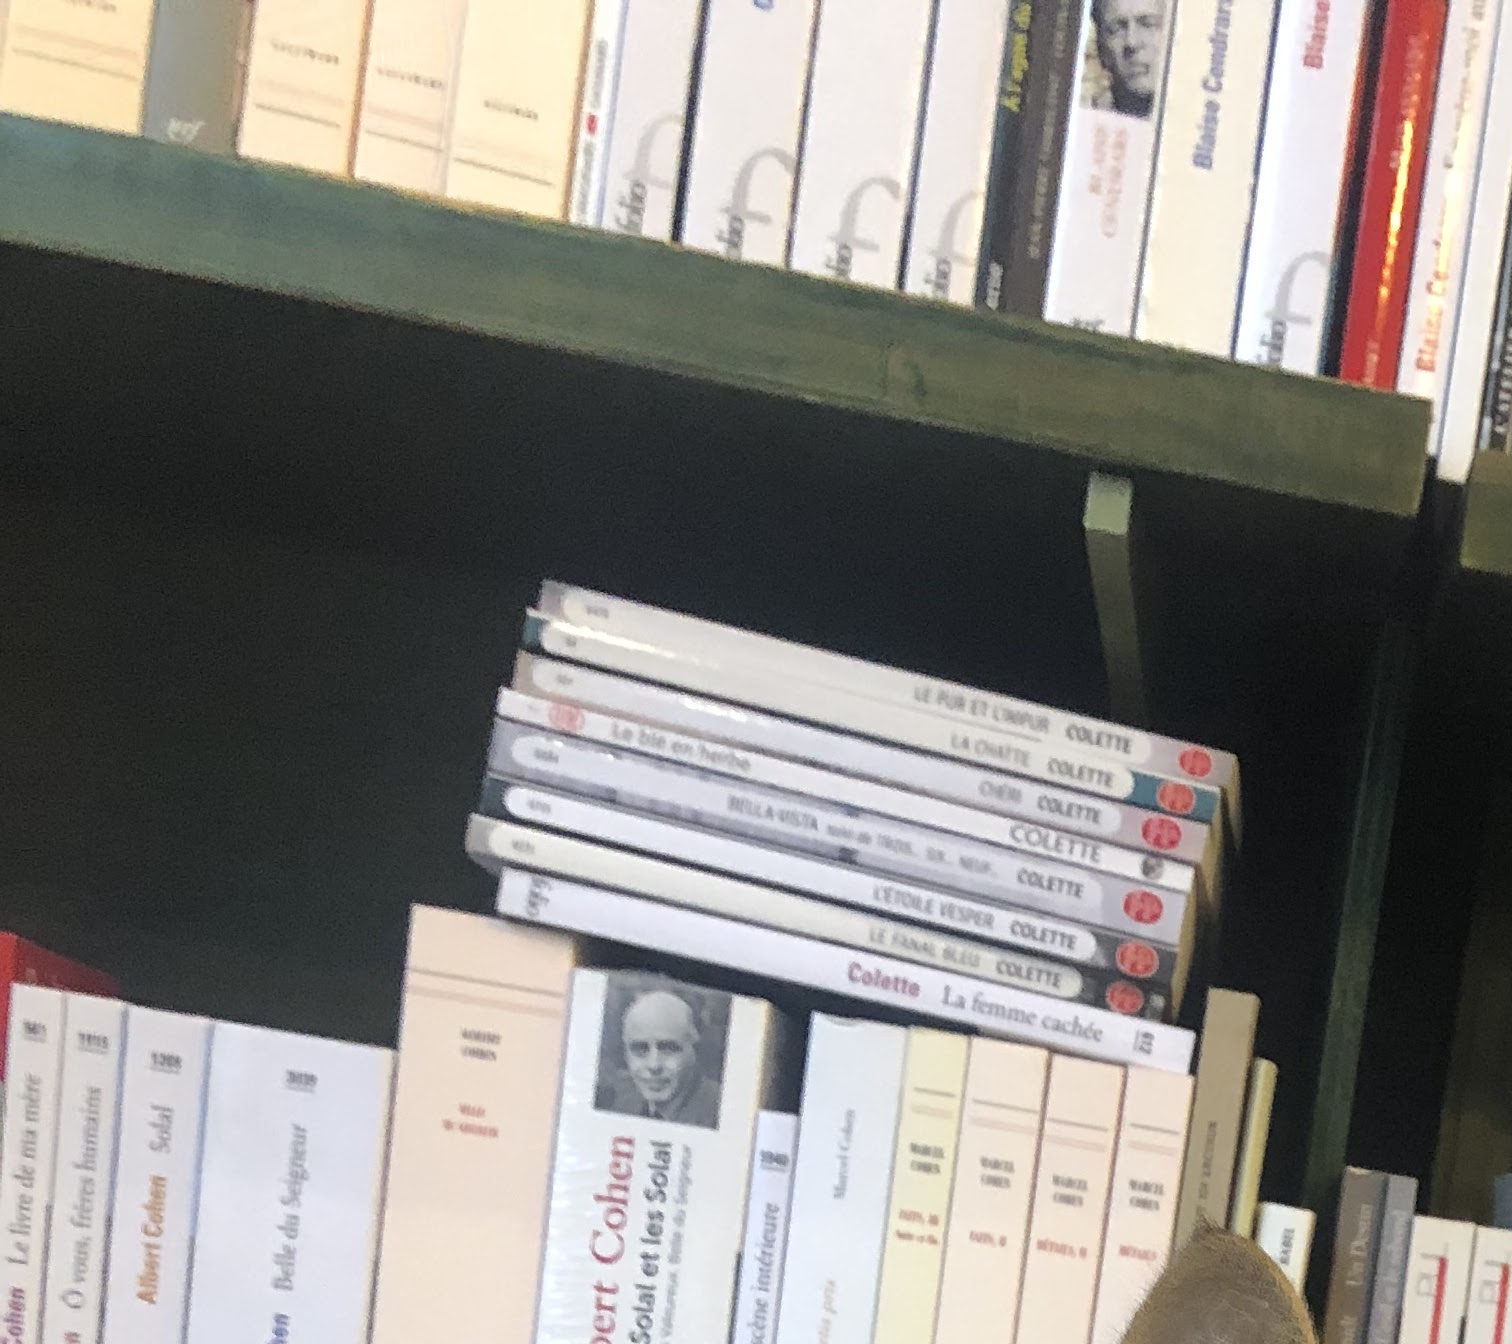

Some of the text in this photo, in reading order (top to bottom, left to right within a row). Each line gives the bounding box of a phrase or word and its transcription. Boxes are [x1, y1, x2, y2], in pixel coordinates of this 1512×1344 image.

[1192, 100, 1222, 171] Blaise
[1065, 722, 1132, 755] COLETTE
[1048, 757, 1115, 788] COLETTE
[611, 722, 1100, 863] Le COLETTE
[1037, 794, 1102, 824] COLETTE
[1016, 867, 1084, 900] COLETTE
[1009, 918, 1078, 952] COLETTE
[996, 958, 1062, 989] COLETTE
[848, 961, 1103, 1043] Colette La femme cachée
[24, 1132, 37, 1160] ma
[19, 1166, 36, 1190] de
[283, 1123, 310, 1208] Seigneur
[646, 1139, 672, 1206] Solal
[136, 1103, 175, 1306] Albert Cohen Solal
[589, 1135, 636, 1266] Cohen
[10, 1196, 34, 1241] livre
[276, 1216, 300, 1239] du
[641, 1211, 665, 1246] les
[7, 1243, 29, 1266] Le
[271, 1245, 298, 1293] Belle
[640, 1249, 660, 1278] et
